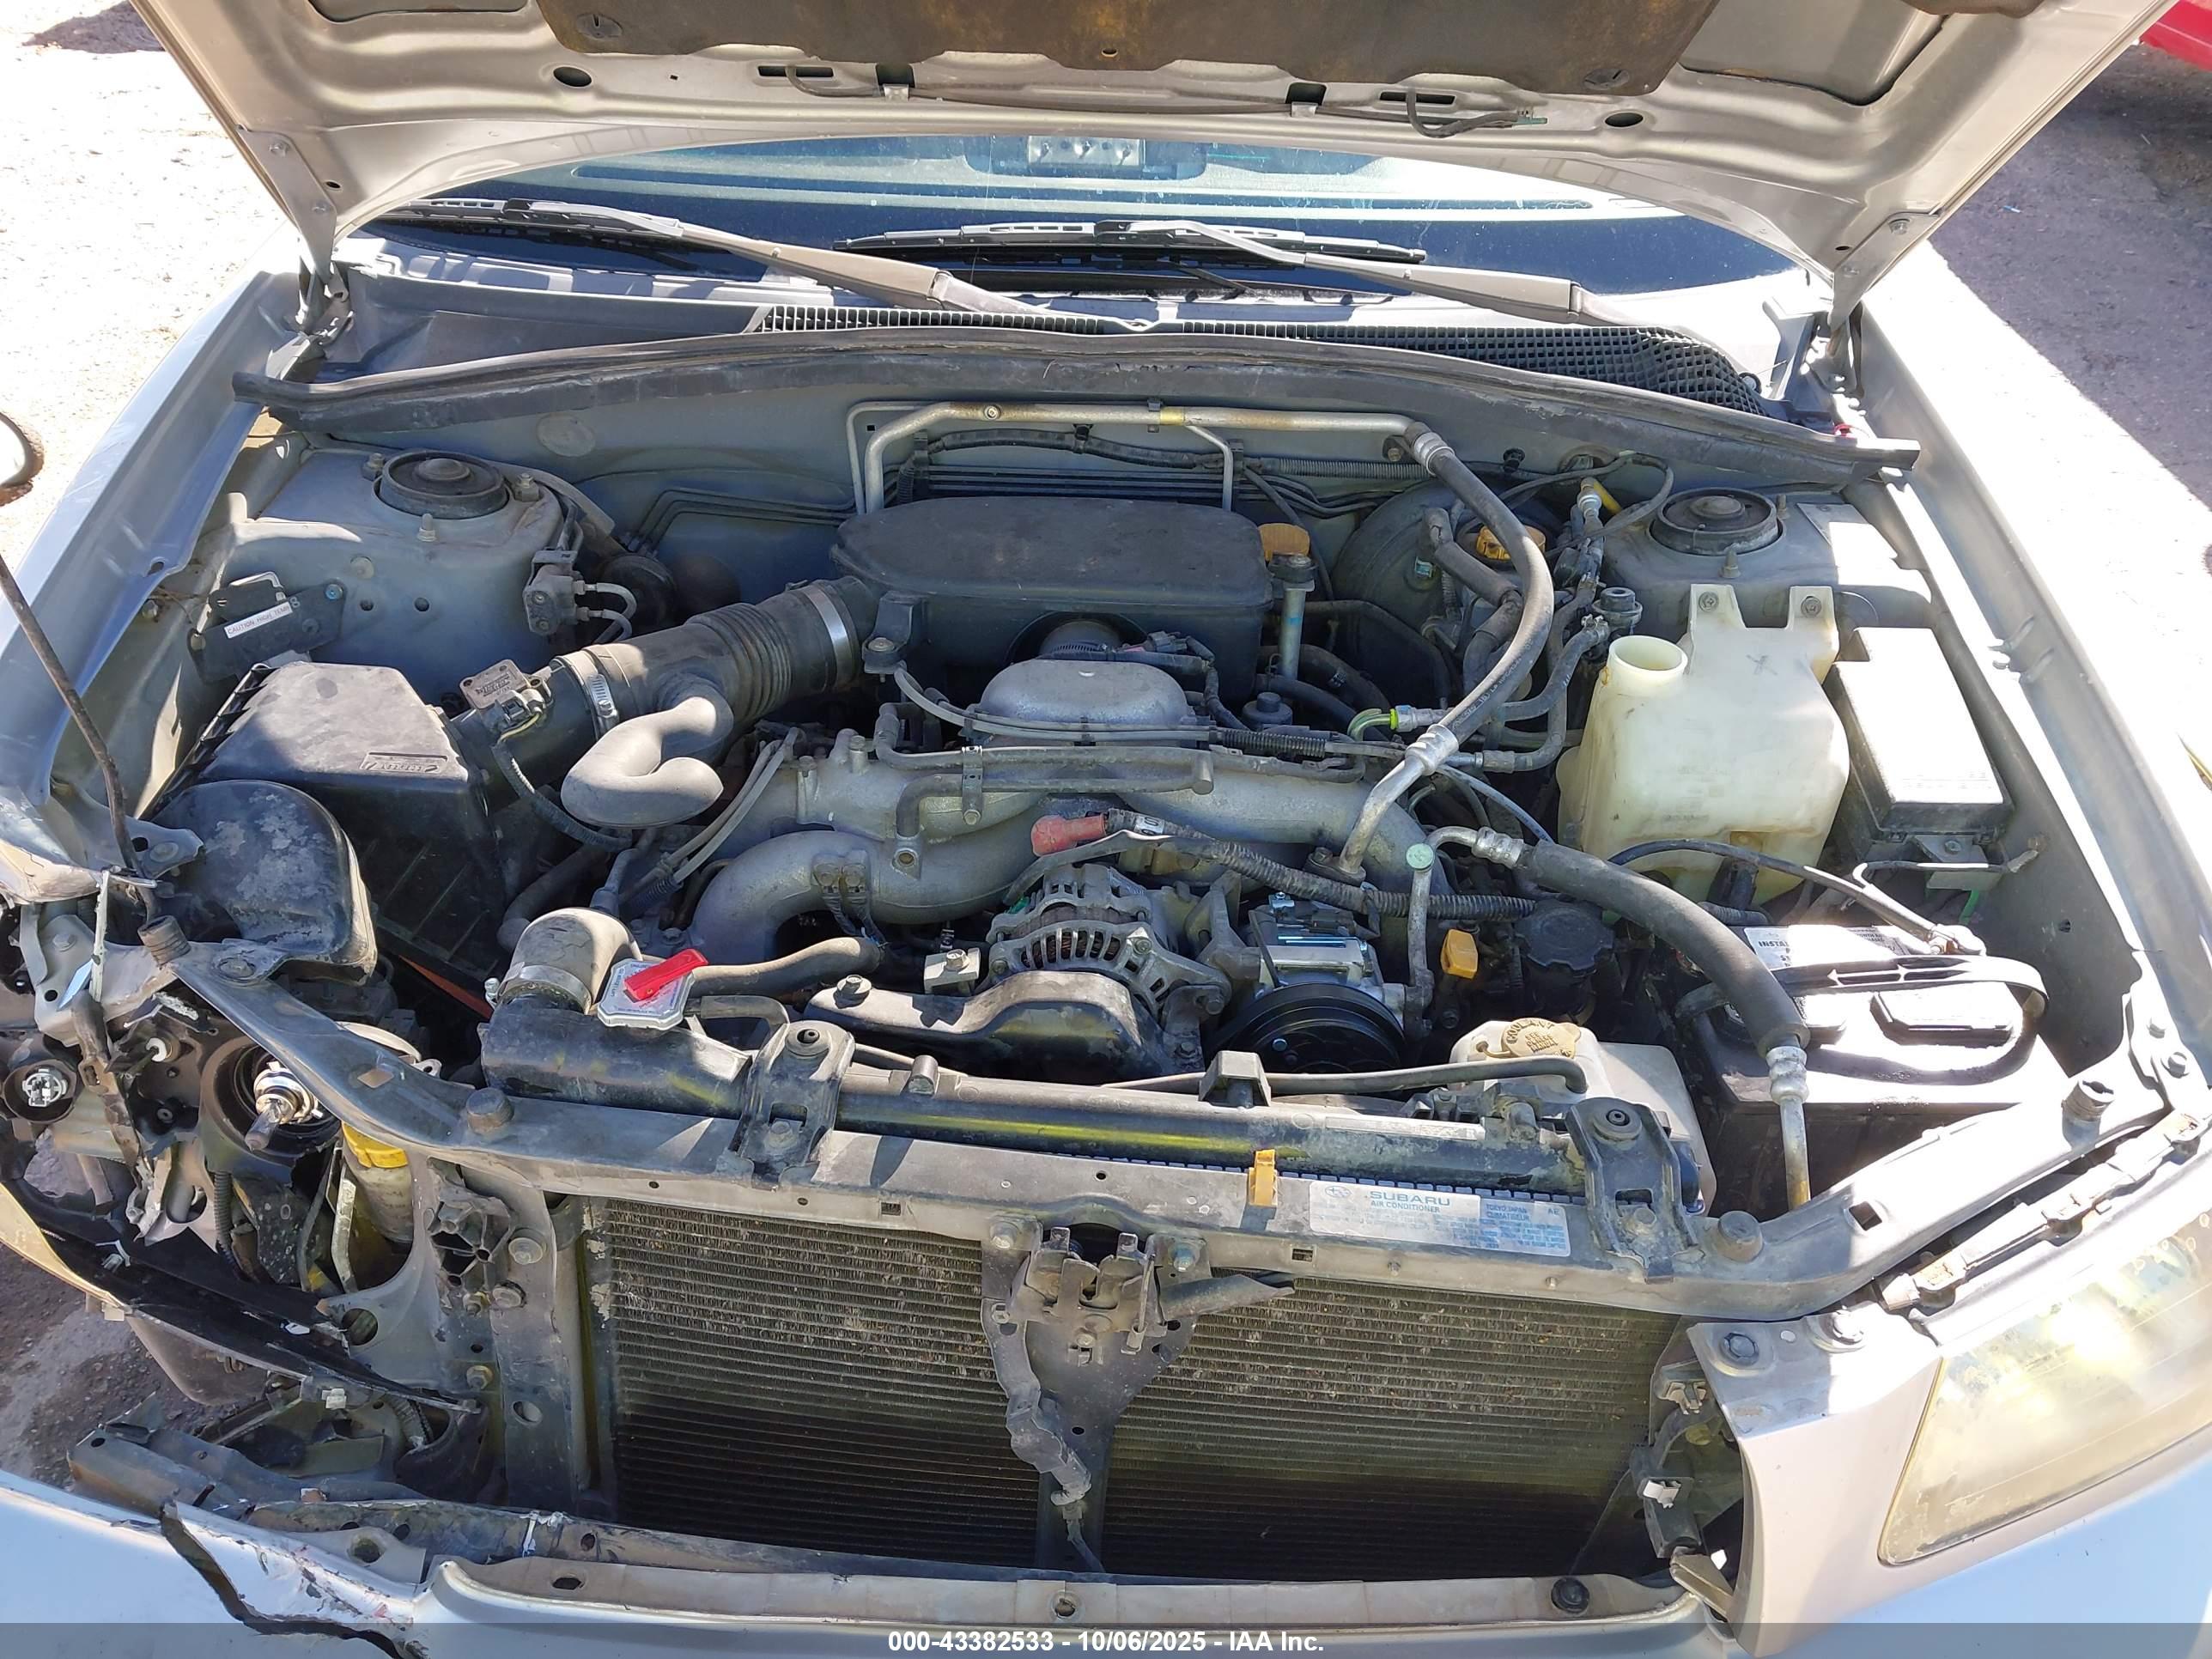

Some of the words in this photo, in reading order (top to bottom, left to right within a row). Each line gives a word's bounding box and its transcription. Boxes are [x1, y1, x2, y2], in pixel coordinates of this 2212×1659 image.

[228, 620, 255, 635] CAUTION
[1505, 1019, 1556, 1045] COOLANT
[1370, 1190, 1450, 1206] SUBARU
[1386, 1201, 1441, 1213] CONDITIONER
